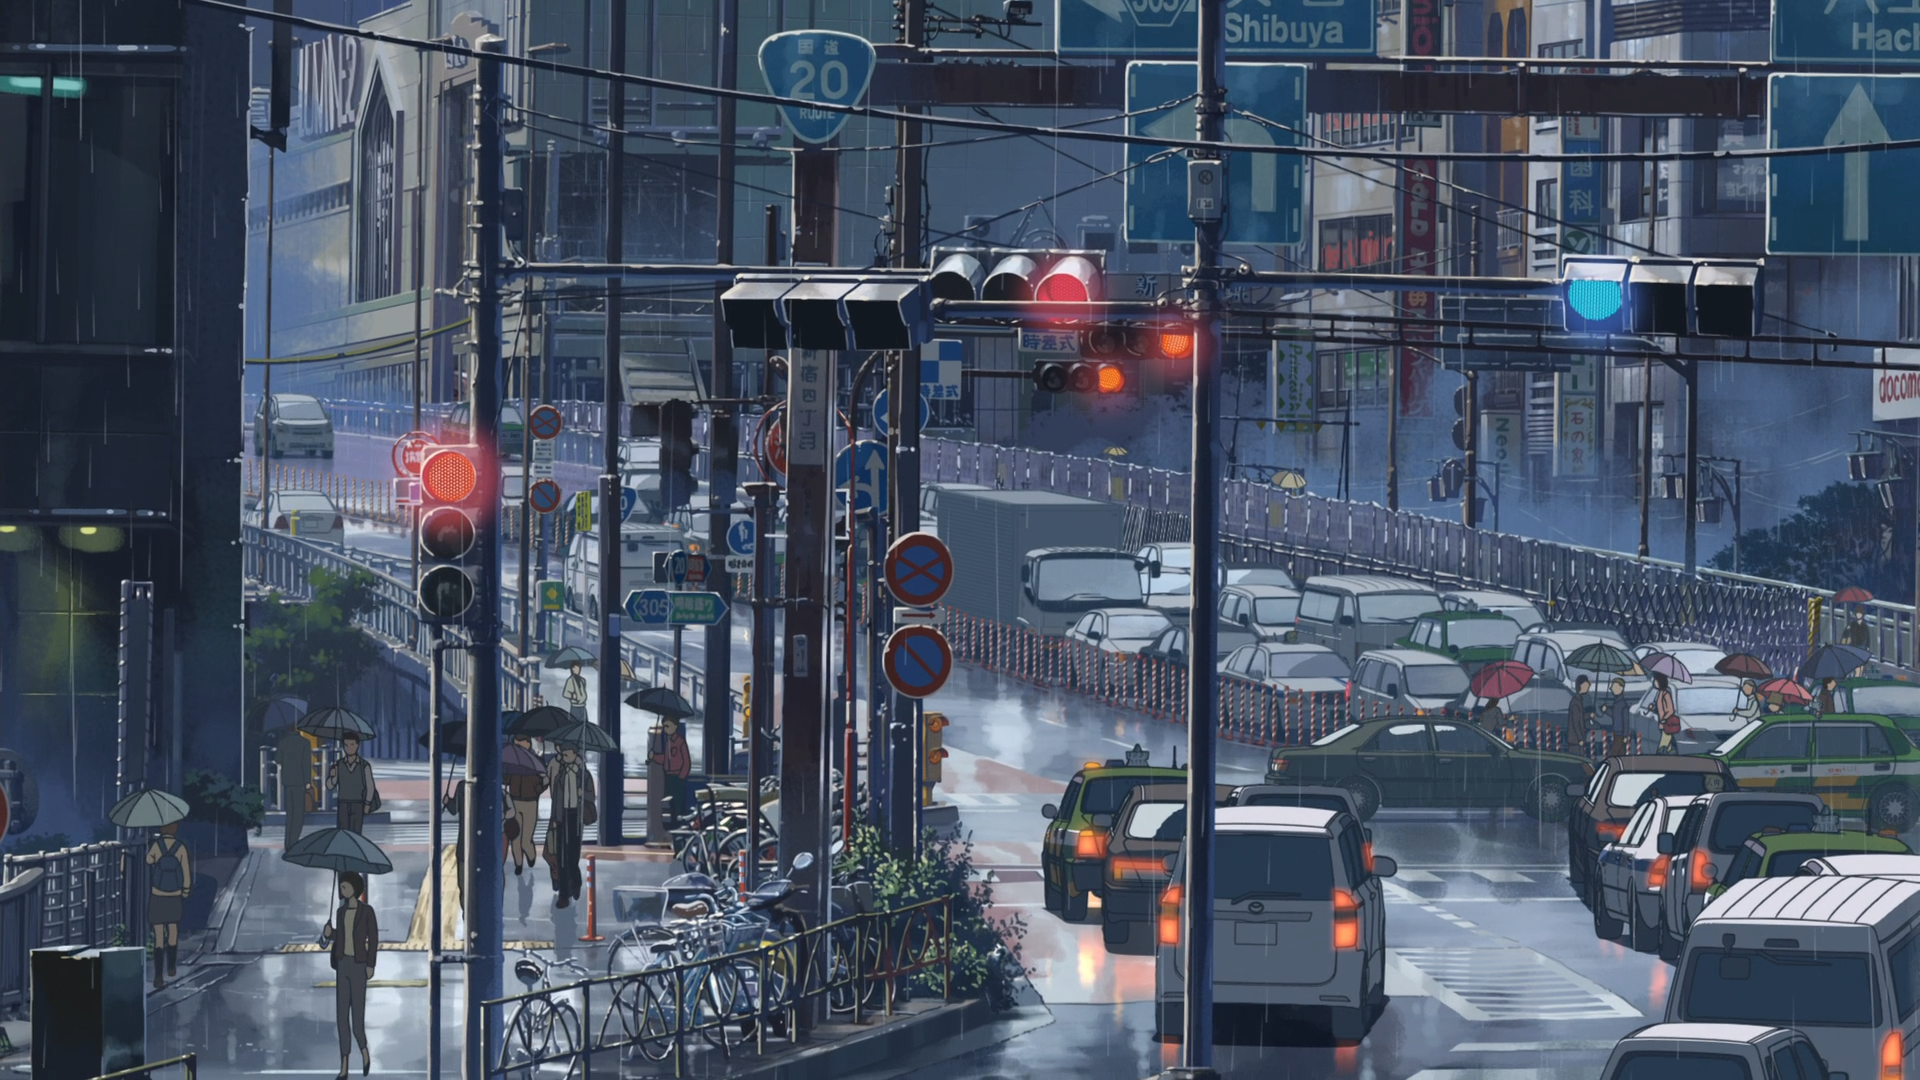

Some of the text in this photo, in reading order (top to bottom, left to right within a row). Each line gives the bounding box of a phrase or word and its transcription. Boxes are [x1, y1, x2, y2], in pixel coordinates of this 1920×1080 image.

[1226, 13, 1344, 48] Shibuya
[798, 39, 839, 55] 国道
[789, 60, 849, 100] 20
[1409, 160, 1430, 237] GOLD
[1022, 334, 1076, 351] 時差式
[674, 557, 686, 574] 20
[638, 598, 668, 616] 305
